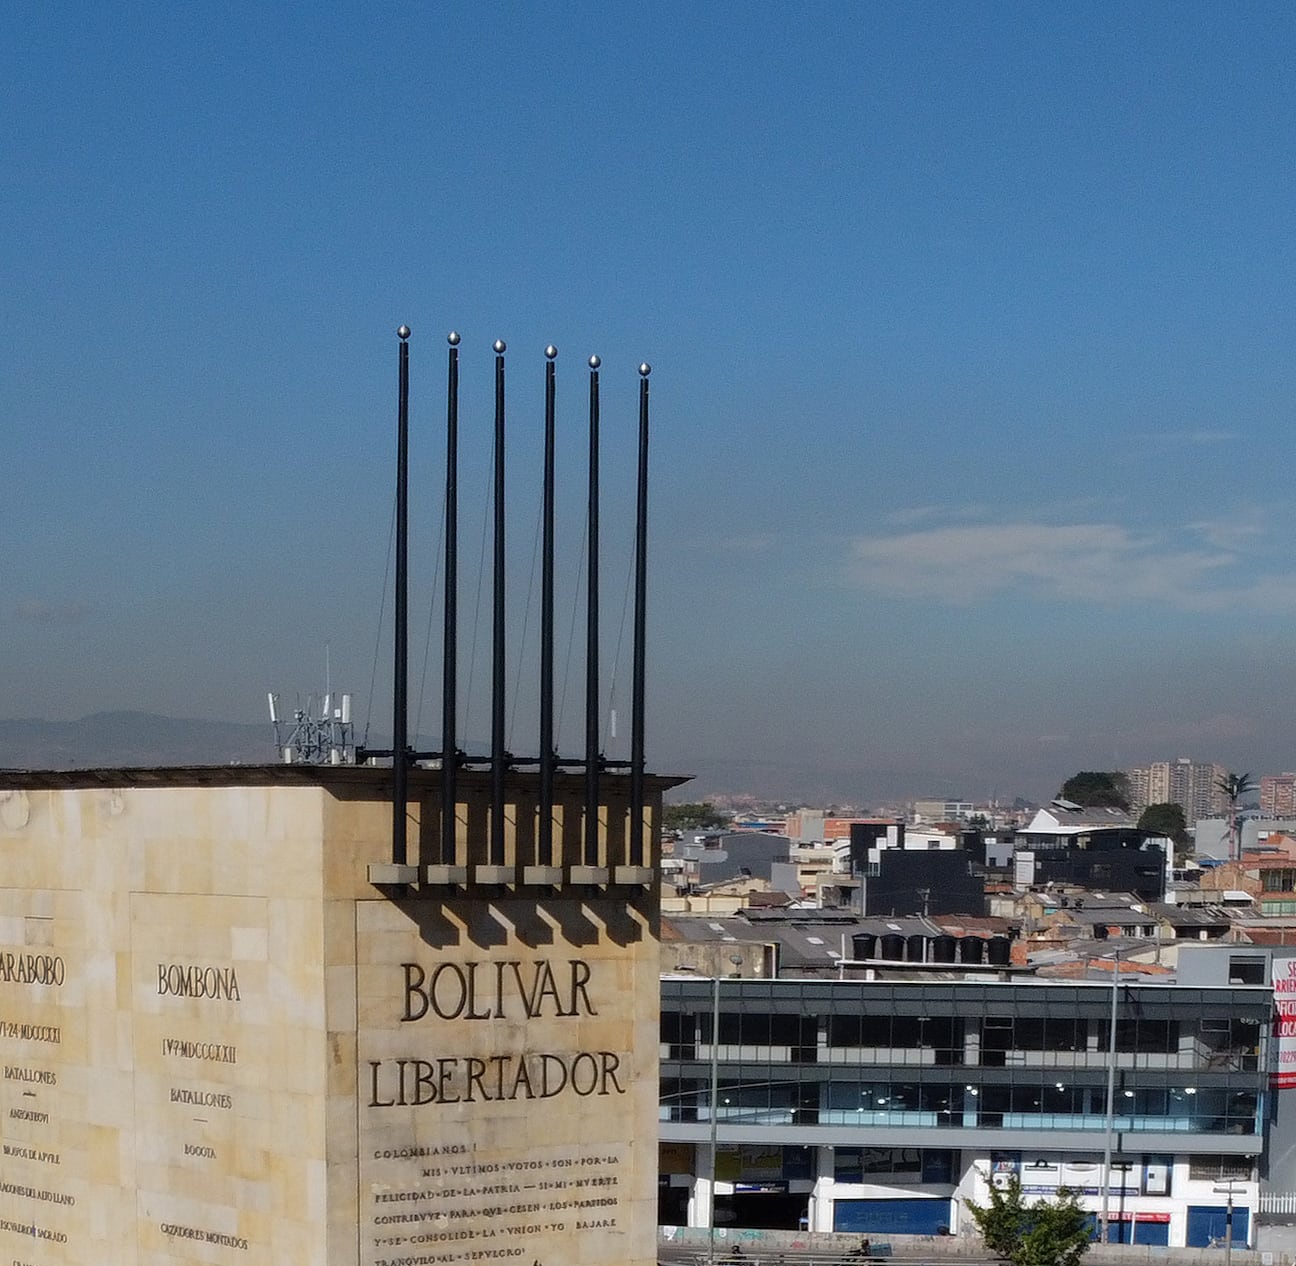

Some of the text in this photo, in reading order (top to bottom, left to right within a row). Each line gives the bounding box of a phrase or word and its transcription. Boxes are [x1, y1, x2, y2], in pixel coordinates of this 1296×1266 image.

[158, 964, 241, 1001] BOMBONA
[402, 960, 598, 1022] BOLIVAR
[4, 1066, 57, 1085] BATALLONES
[368, 1052, 626, 1108] LIBERTADOR
[170, 1088, 233, 1109] BATALLONES
[374, 1144, 467, 1159] COLOMBIANOS
[507, 1161, 543, 1171] VOTOS
[552, 1159, 572, 1168] SON
[581, 1157, 602, 1166] POR
[607, 1156, 619, 1164] LA
[375, 1190, 434, 1203] FELICIDAD
[442, 1189, 456, 1198] DE
[464, 1188, 476, 1196] LA
[482, 1185, 520, 1195] PATRIA
[450, 1209, 477, 1219] PARA
[509, 1203, 540, 1214] CESEN
[549, 1201, 567, 1211] LOS
[388, 1237, 402, 1246] SE
[410, 1230, 475, 1244] CONSOLIDE
[482, 1229, 496, 1238] LA
[506, 1224, 541, 1235] VNION
[550, 1223, 565, 1232] YO
[576, 1219, 617, 1230] BAJARE
[441, 1254, 455, 1263] AL
